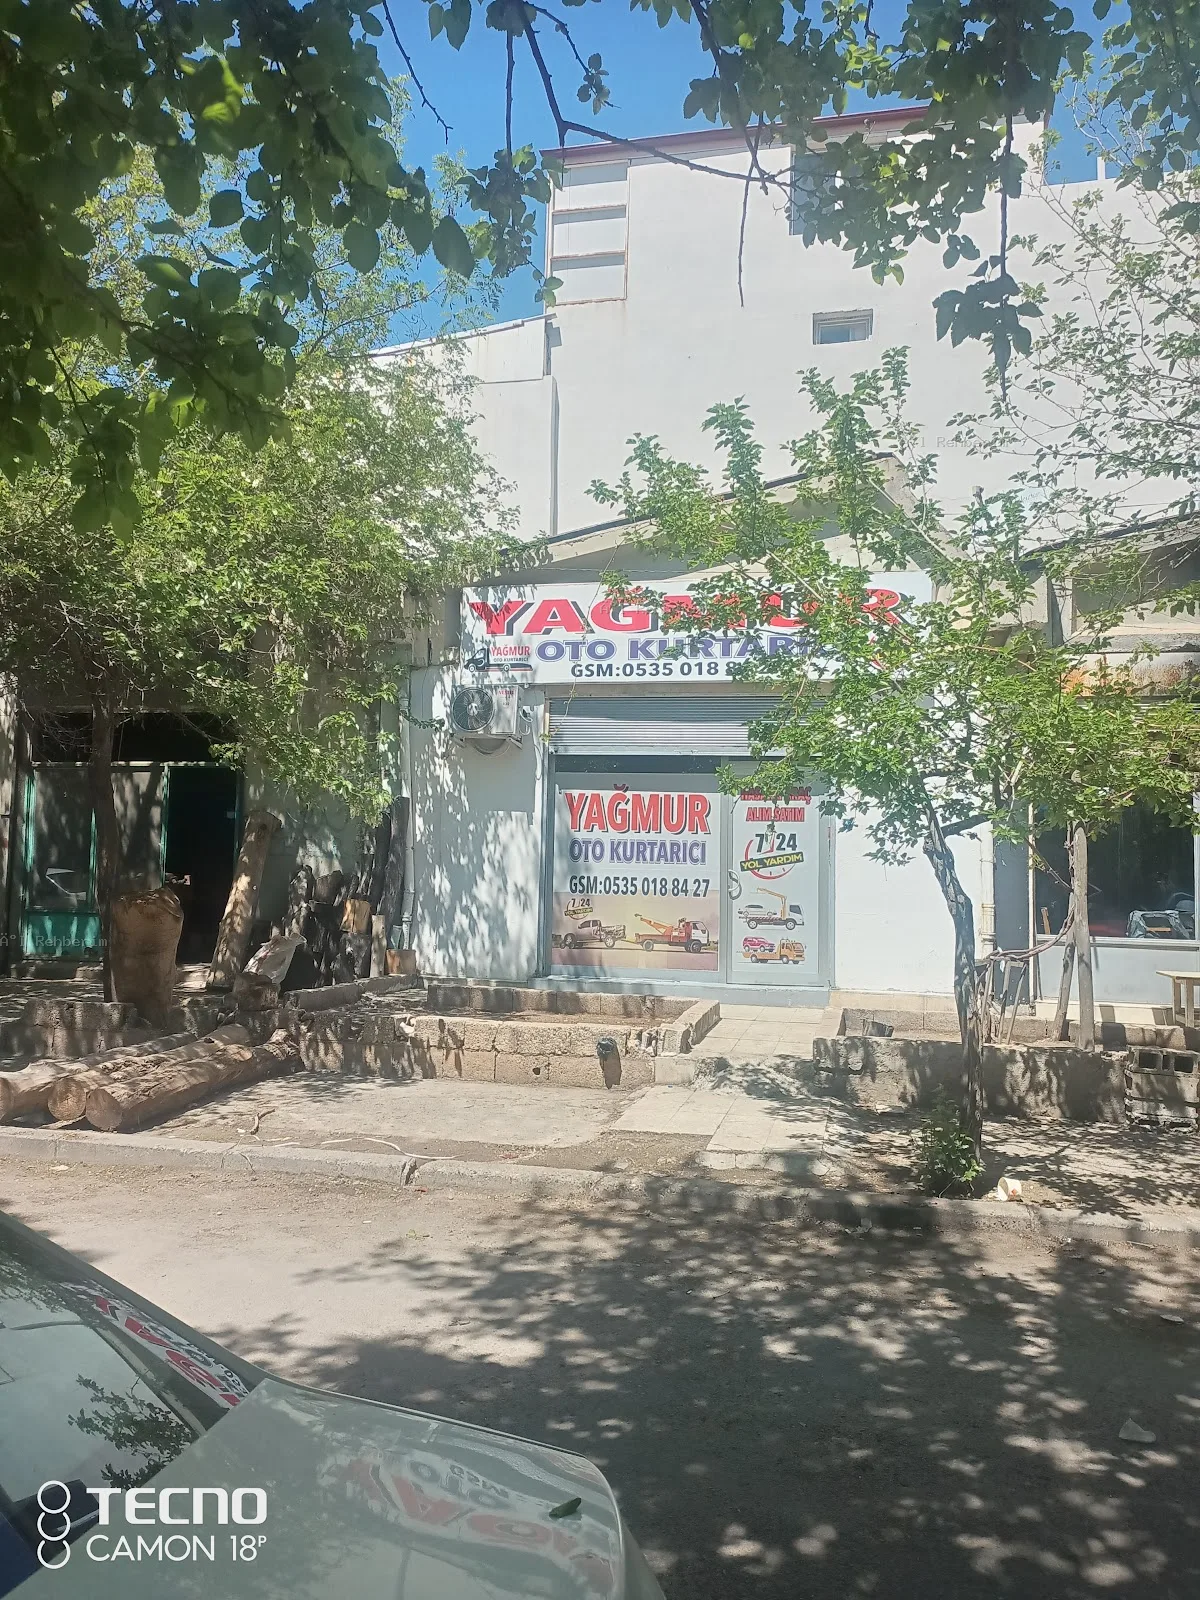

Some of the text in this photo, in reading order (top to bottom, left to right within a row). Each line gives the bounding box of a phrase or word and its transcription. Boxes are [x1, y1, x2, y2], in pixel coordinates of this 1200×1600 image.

[491, 644, 530, 657] YAĞMUR
[535, 639, 617, 663] OTO
[571, 662, 673, 677] GSM:0535
[680, 661, 719, 676] 018
[565, 784, 711, 835] YAĞMUR
[746, 807, 805, 822] ALIM SATIM
[569, 838, 707, 865] OTO KURTARICI
[755, 833, 797, 852] 7 24
[741, 853, 803, 870] YOL YARDIM
[569, 875, 711, 898] GSM:0535 018 84 27
